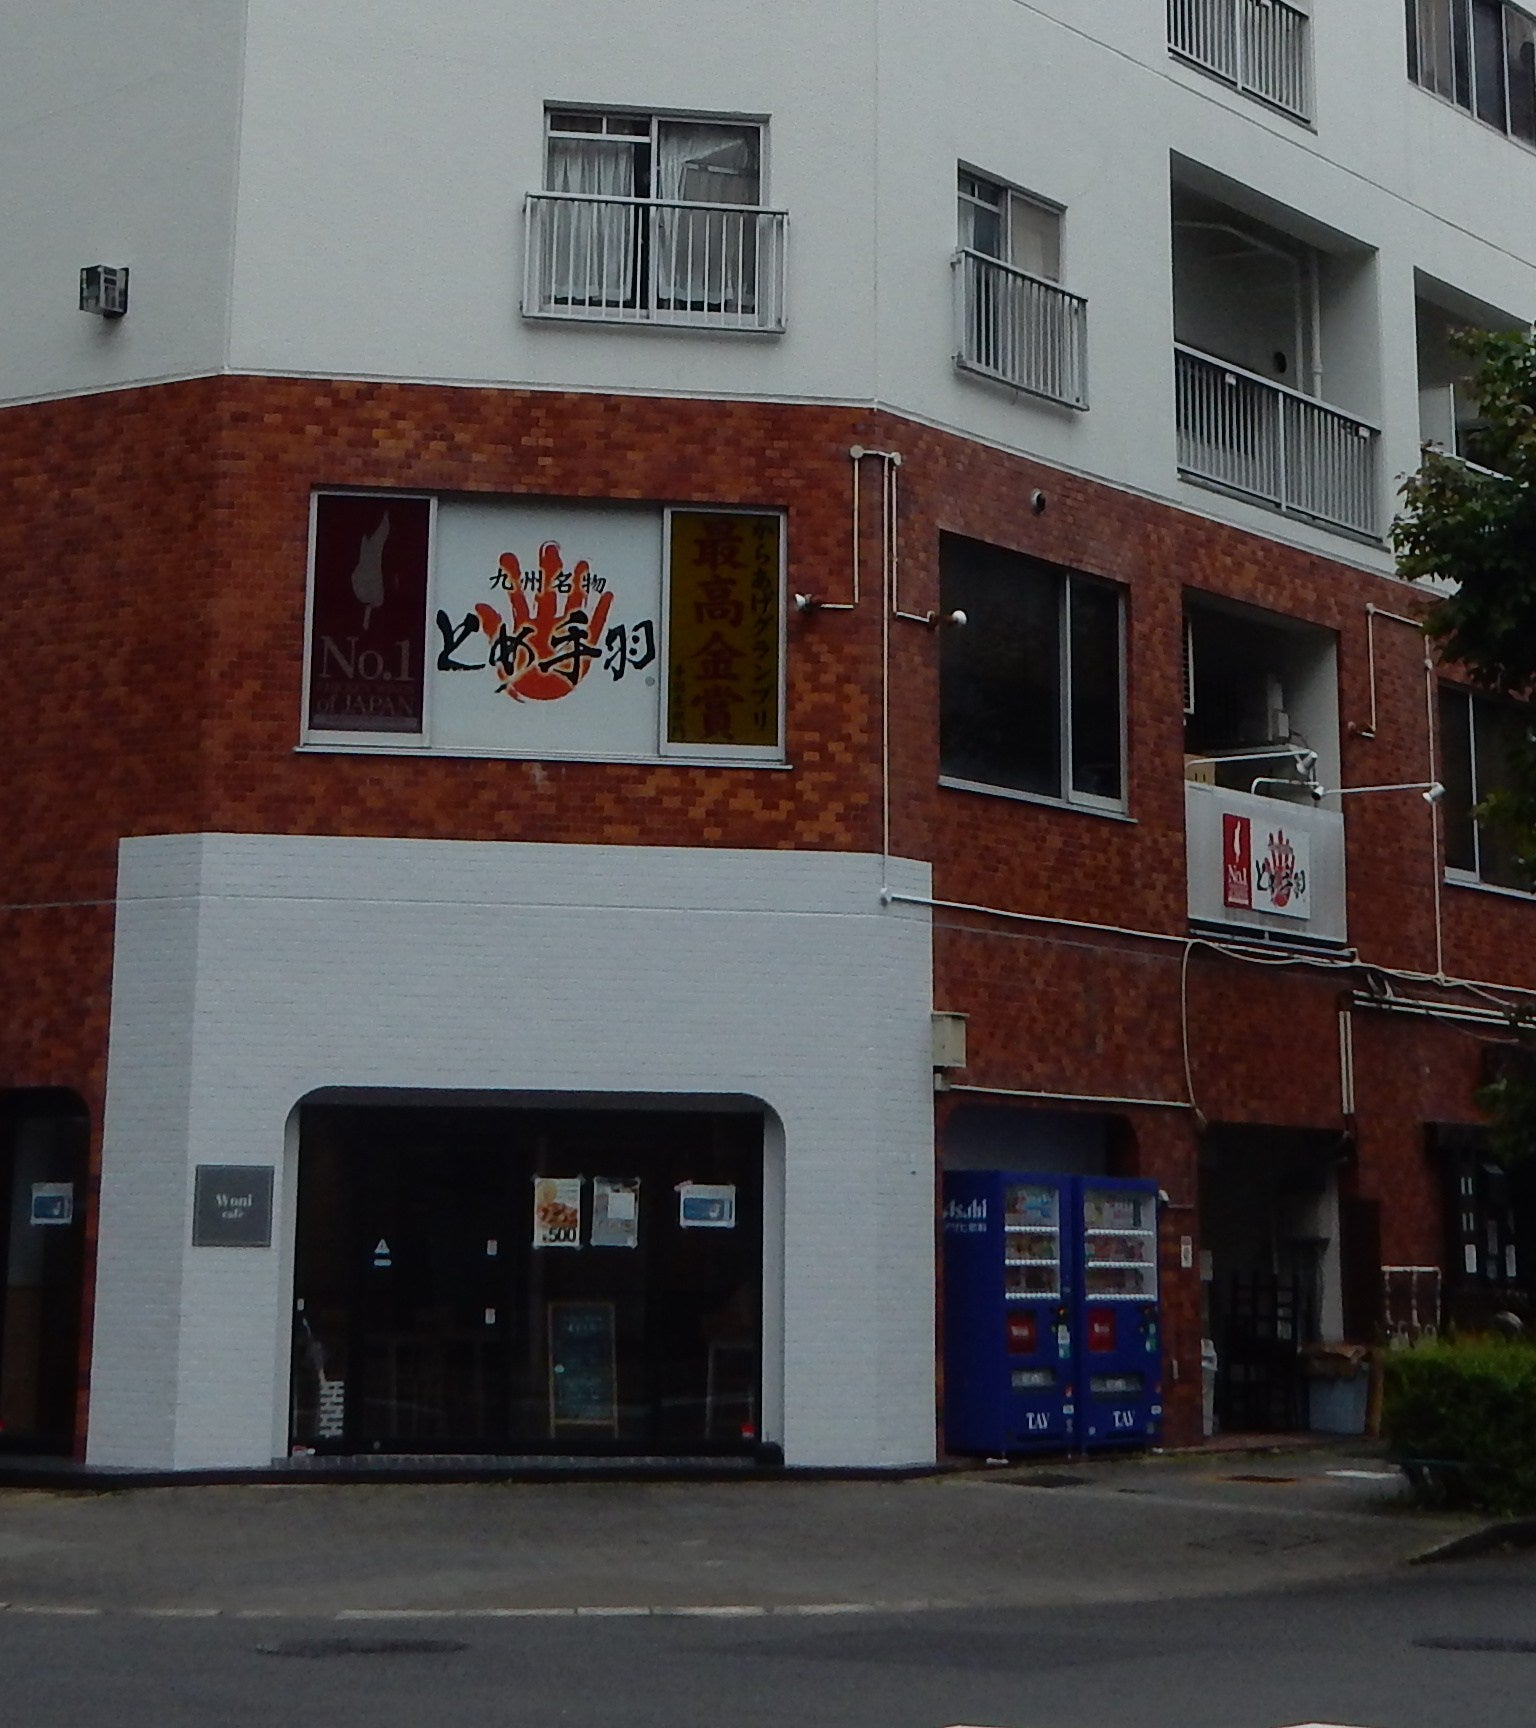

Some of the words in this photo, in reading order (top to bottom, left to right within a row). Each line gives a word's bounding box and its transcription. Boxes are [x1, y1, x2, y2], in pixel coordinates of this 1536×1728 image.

[489, 569, 608, 596] 九州名物
[437, 608, 656, 694] とめ手羽
[690, 519, 747, 741] 最高金賞
[320, 635, 415, 682] No.1
[317, 694, 337, 713] of
[344, 694, 413, 715] JAPAN
